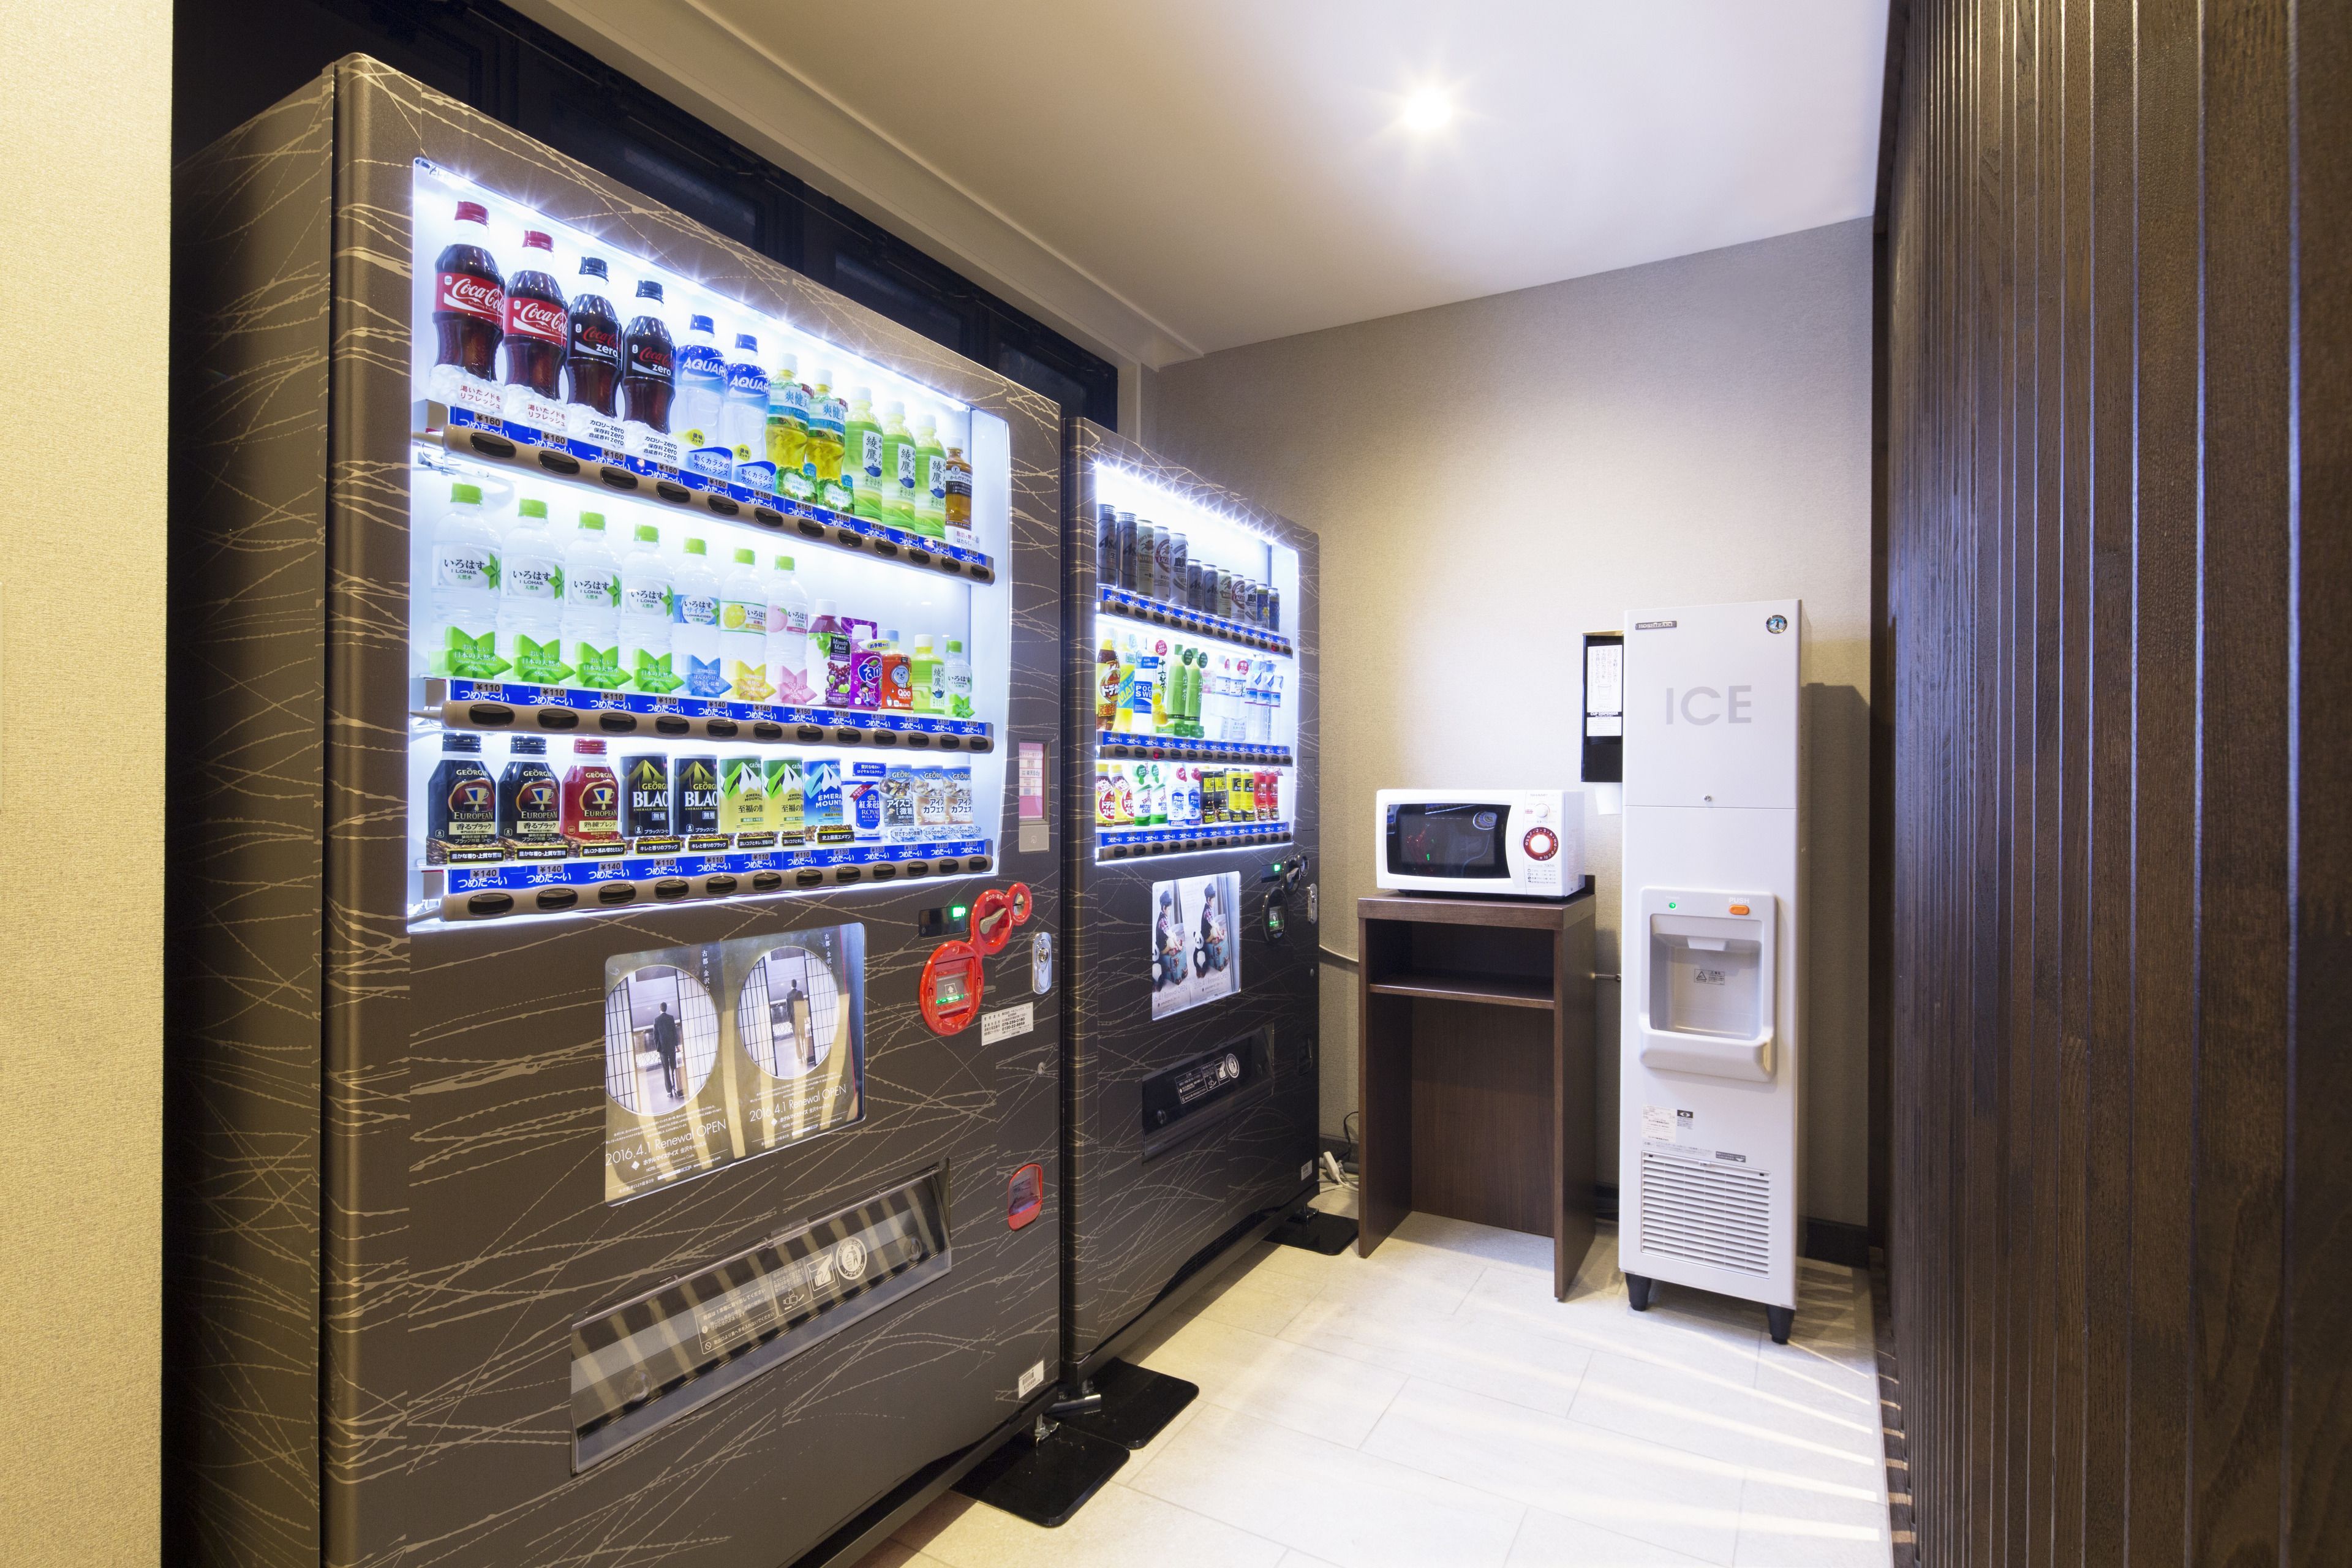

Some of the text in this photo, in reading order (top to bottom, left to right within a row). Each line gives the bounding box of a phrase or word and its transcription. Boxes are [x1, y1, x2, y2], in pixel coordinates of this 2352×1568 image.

[596, 344, 618, 358] zero
[652, 364, 671, 376] zero
[461, 385, 500, 402] 渇いたノドを
[461, 393, 500, 409] リフレッシュ
[528, 404, 566, 420] 渇いたノドを
[529, 412, 565, 426] リフレッシュ
[476, 413, 500, 426] ¥160
[543, 432, 565, 444] ¥160
[604, 450, 624, 461] ¥160
[866, 436, 878, 462] 綾鷹
[694, 454, 729, 469] 動くカラダの
[900, 449, 911, 474] 綾鷹
[659, 464, 677, 474] ¥160
[693, 462, 728, 476] 水分バランス
[742, 469, 774, 483] 動くカラダの
[931, 461, 943, 485] 綾鷹
[741, 475, 772, 489] 水分バランス
[444, 559, 484, 570] いろはす
[513, 570, 551, 581] いろはす
[574, 580, 609, 590] いろはす
[631, 590, 663, 600] いろはす
[453, 652, 497, 662] 日本の天然水
[522, 658, 562, 667] 日本の天然水
[858, 663, 882, 682] Fant
[933, 668, 941, 687] 綾鷹
[897, 688, 910, 697] Qoo
[1666, 685, 1752, 726] ICE
[633, 791, 668, 807] BLAC
[684, 791, 717, 807] BLAC
[887, 799, 912, 808] アイスコ
[750, 1102, 786, 1122] 2016.4.1
[789, 1091, 820, 1109] Renewal
[822, 1084, 846, 1099] OPEN
[605, 1142, 651, 1166] 2016.4.1
[655, 1129, 694, 1150] Renewal
[696, 1118, 726, 1137] OPEN
[844, 1262, 864, 1277] リサイクル
